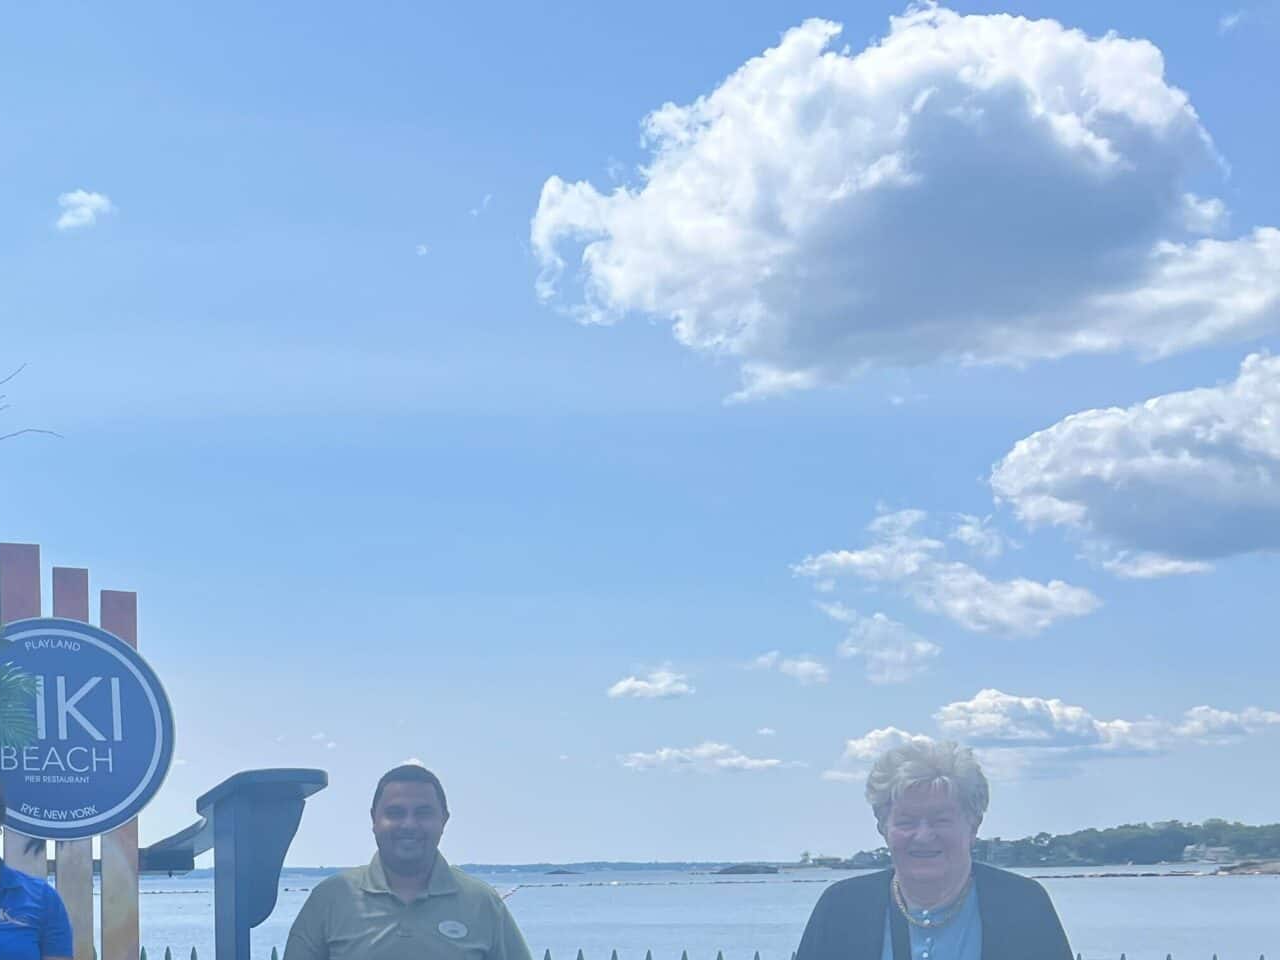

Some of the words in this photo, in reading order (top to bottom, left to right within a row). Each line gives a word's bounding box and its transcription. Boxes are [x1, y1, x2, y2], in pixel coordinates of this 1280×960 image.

[24, 639, 81, 652] PLAYLAND
[0, 747, 113, 773] BEACH
[25, 775, 41, 784] PIER
[42, 775, 90, 784] RESTAURANT
[43, 808, 67, 820] NEW
[70, 804, 98, 818] YORK
